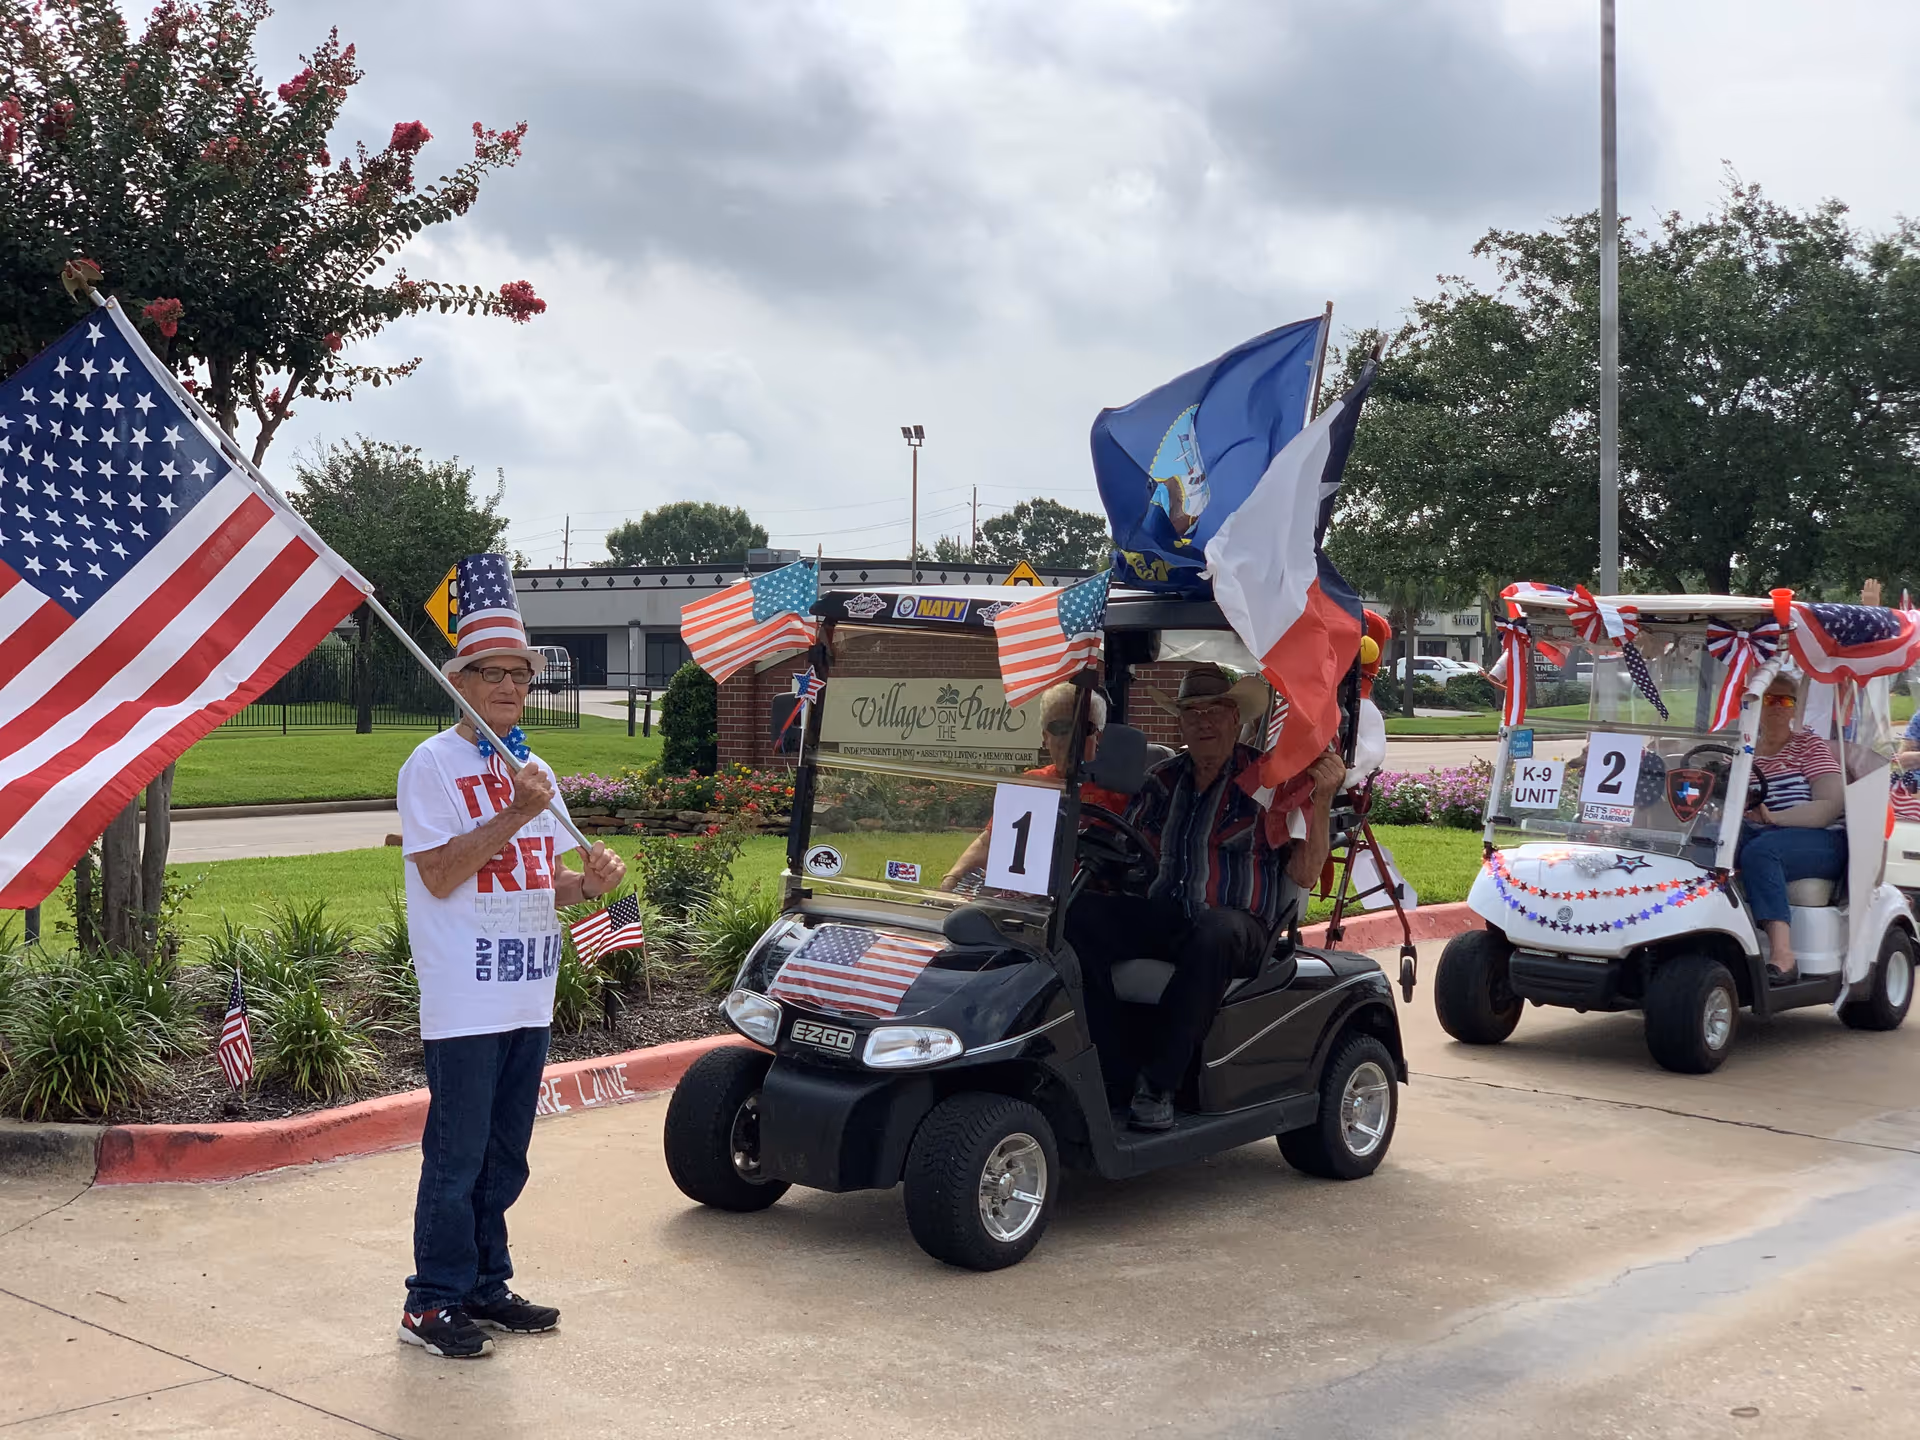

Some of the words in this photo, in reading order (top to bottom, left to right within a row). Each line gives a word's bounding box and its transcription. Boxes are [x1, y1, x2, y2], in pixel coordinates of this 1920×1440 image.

[917, 599, 966, 618] NAVY
[852, 682, 936, 740] Village
[938, 710, 957, 724] ON
[959, 684, 1026, 732] Park
[937, 725, 956, 739] THE
[844, 746, 891, 756] INDEPENDENT
[893, 748, 914, 757] LIVING
[921, 749, 953, 758] ASSISTED
[954, 751, 977, 759] LIVING
[983, 752, 1013, 760] MEMORY
[1015, 752, 1032, 761] CARE
[1523, 766, 1552, 782] K-9
[1597, 751, 1626, 795] 2
[1515, 787, 1558, 804] UNIT
[1584, 812, 1599, 820] FOR
[1599, 814, 1630, 823] AMERICA
[1585, 804, 1607, 814] LET'S
[1609, 808, 1632, 816] PRAY
[1008, 811, 1032, 875] 1
[888, 861, 917, 881] USA
[476, 937, 493, 981] AND
[793, 1023, 854, 1050] EZGO
[575, 1063, 635, 1106] LANE
